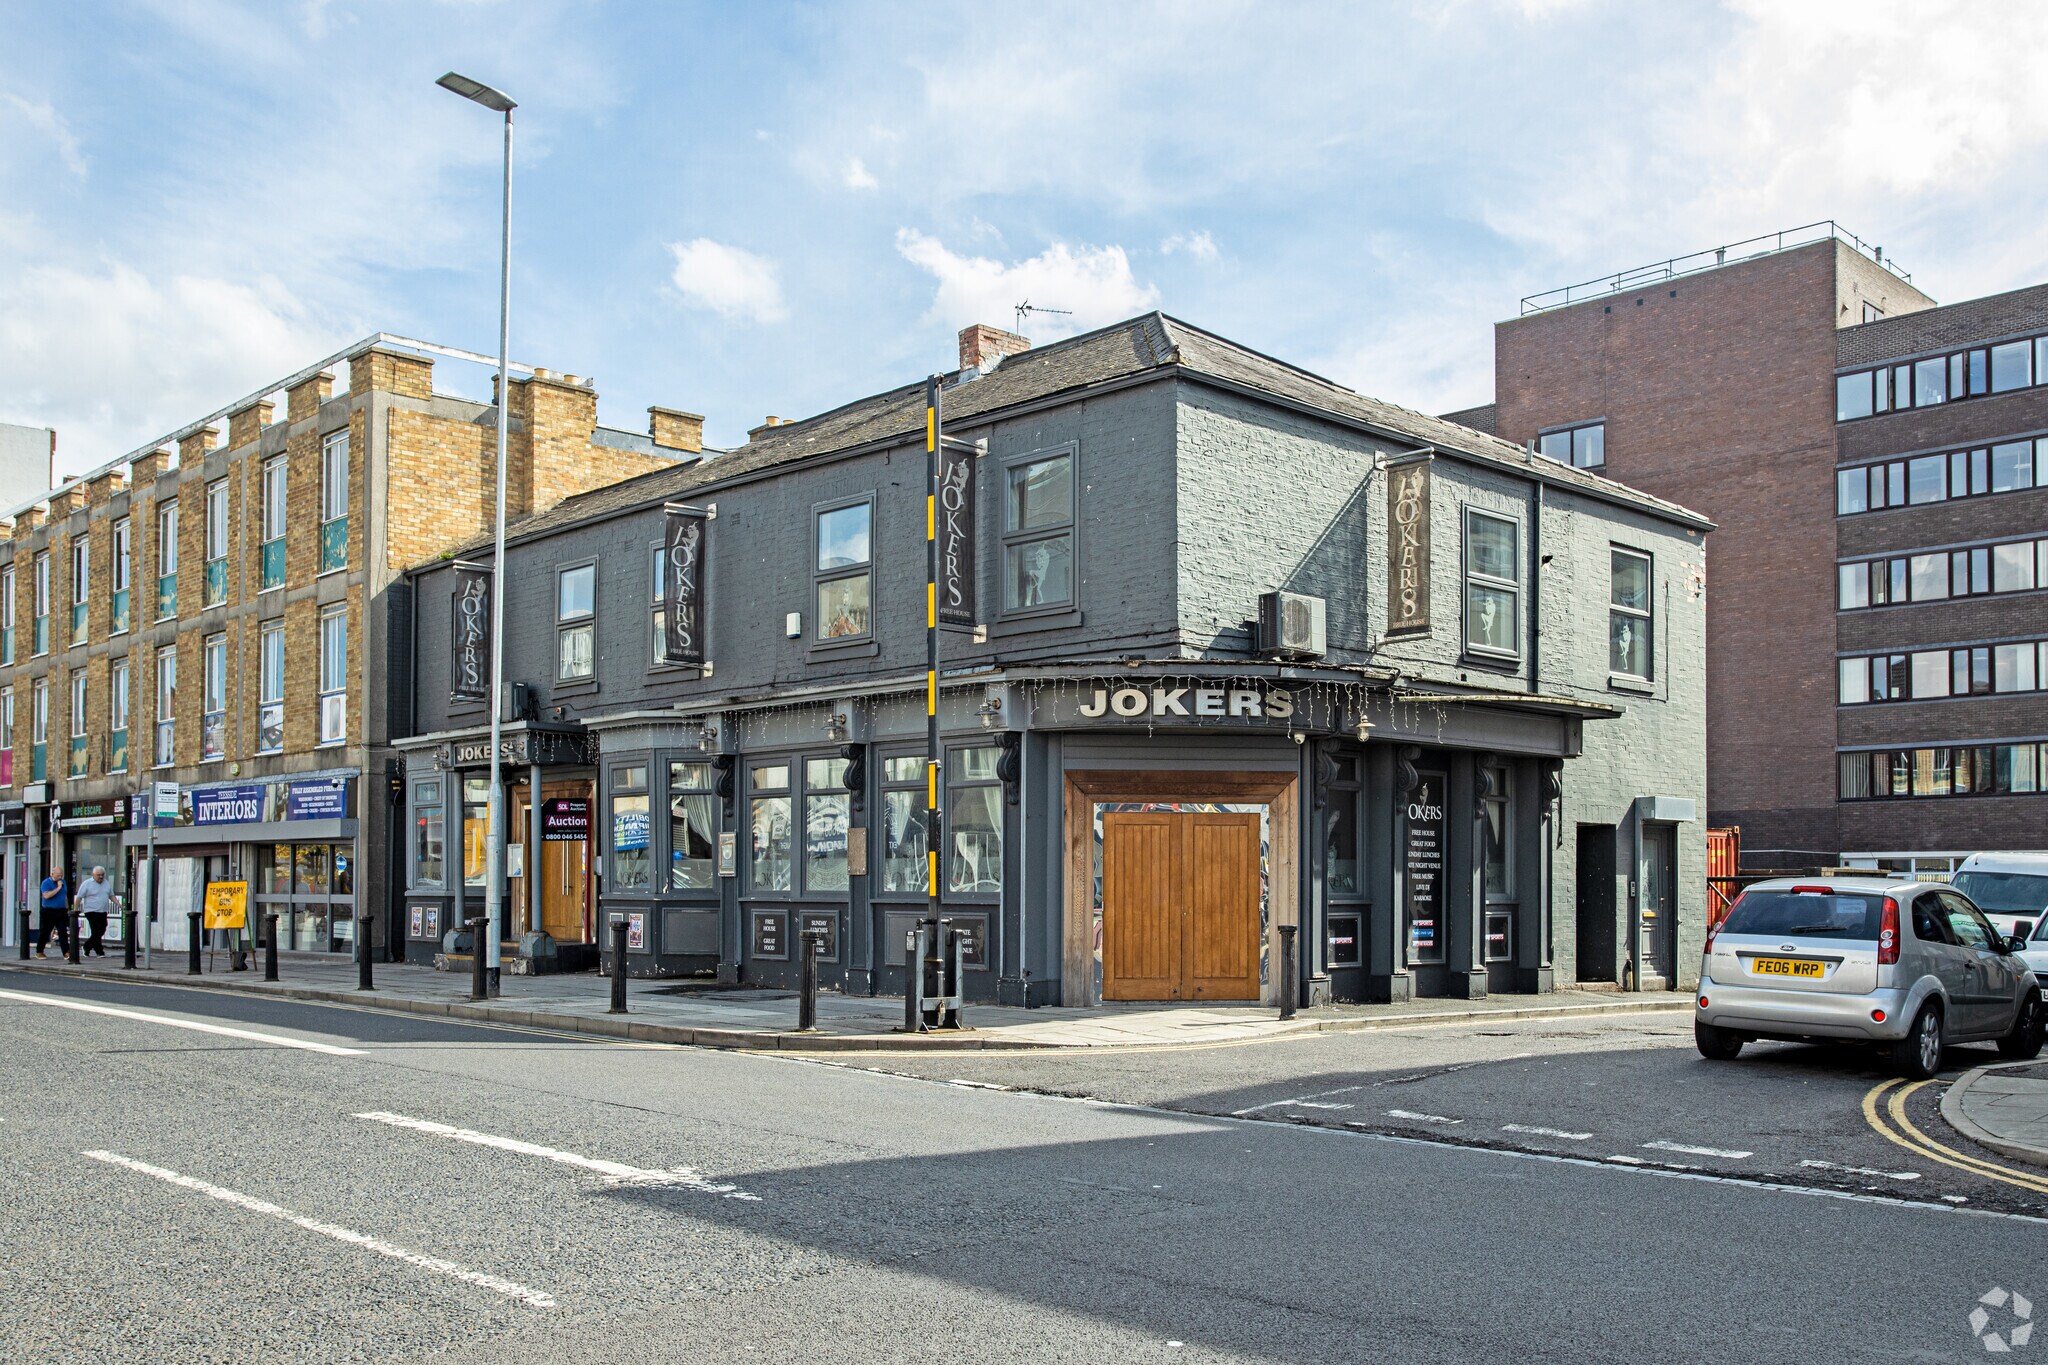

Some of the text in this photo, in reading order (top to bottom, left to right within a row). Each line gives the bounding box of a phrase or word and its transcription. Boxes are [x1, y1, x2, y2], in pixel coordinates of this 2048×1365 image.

[942, 462, 967, 606] JOKERS
[1395, 477, 1422, 617] JOKERS
[671, 526, 696, 647] JOKERS
[461, 580, 483, 684] JOKERS
[1080, 688, 1294, 718] JOKERS
[457, 743, 509, 761] JOKES
[218, 790, 237, 800] TEESSIDE
[72, 805, 101, 816] VAPE ESCAPE
[199, 799, 257, 821] INTERIORS
[1408, 803, 1442, 821] OKERS
[548, 816, 587, 826] Auction
[210, 887, 244, 896] TEMPORARY
[217, 909, 232, 917] STOP
[1757, 960, 1819, 976] FE06 WRP
